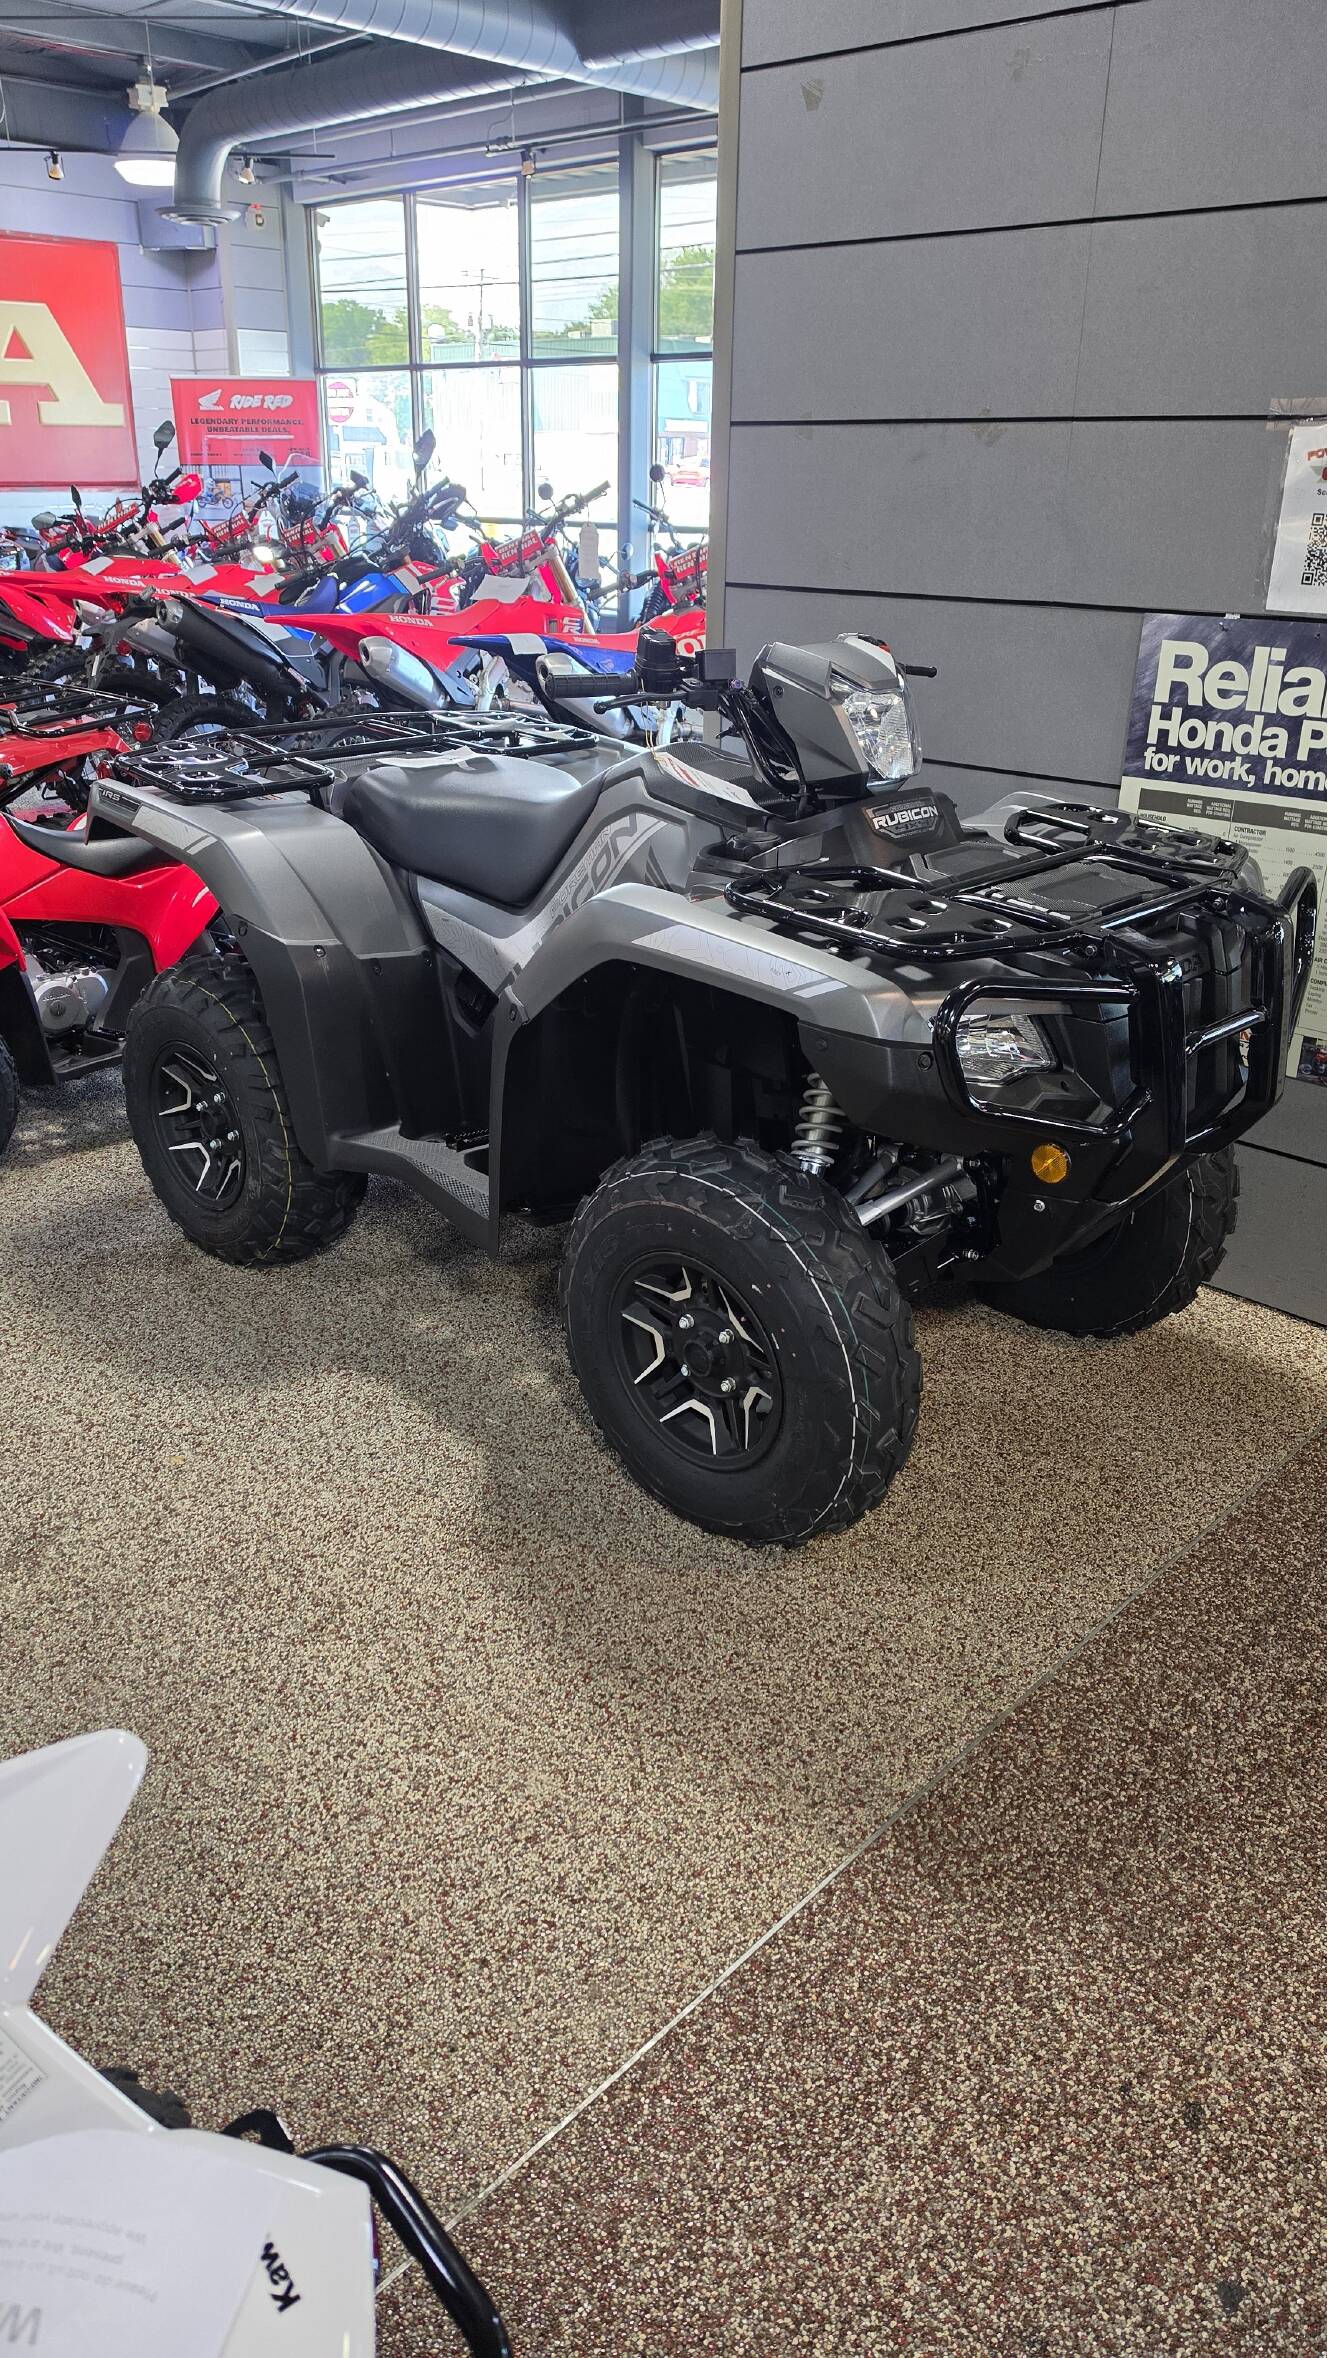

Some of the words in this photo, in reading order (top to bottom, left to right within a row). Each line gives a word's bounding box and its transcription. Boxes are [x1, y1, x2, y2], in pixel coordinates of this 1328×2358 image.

[0, 301, 127, 427] A
[229, 394, 262, 410] RIDE
[263, 394, 294, 411] RED
[190, 417, 239, 426] LEGENDARY
[206, 425, 260, 434] UNBEATABLE
[102, 575, 146, 588] HONDA
[219, 598, 261, 612] HONDA
[389, 614, 434, 627] HONDA
[1153, 639, 1327, 719] Relia
[1146, 704, 1289, 759] Honda
[1296, 719, 1327, 761] P
[1143, 746, 1181, 772] for
[1185, 756, 1256, 787] work,
[102, 789, 121, 802] IRS
[872, 805, 939, 830] RUBICON
[1234, 826, 1267, 837] CONTRACTOR
